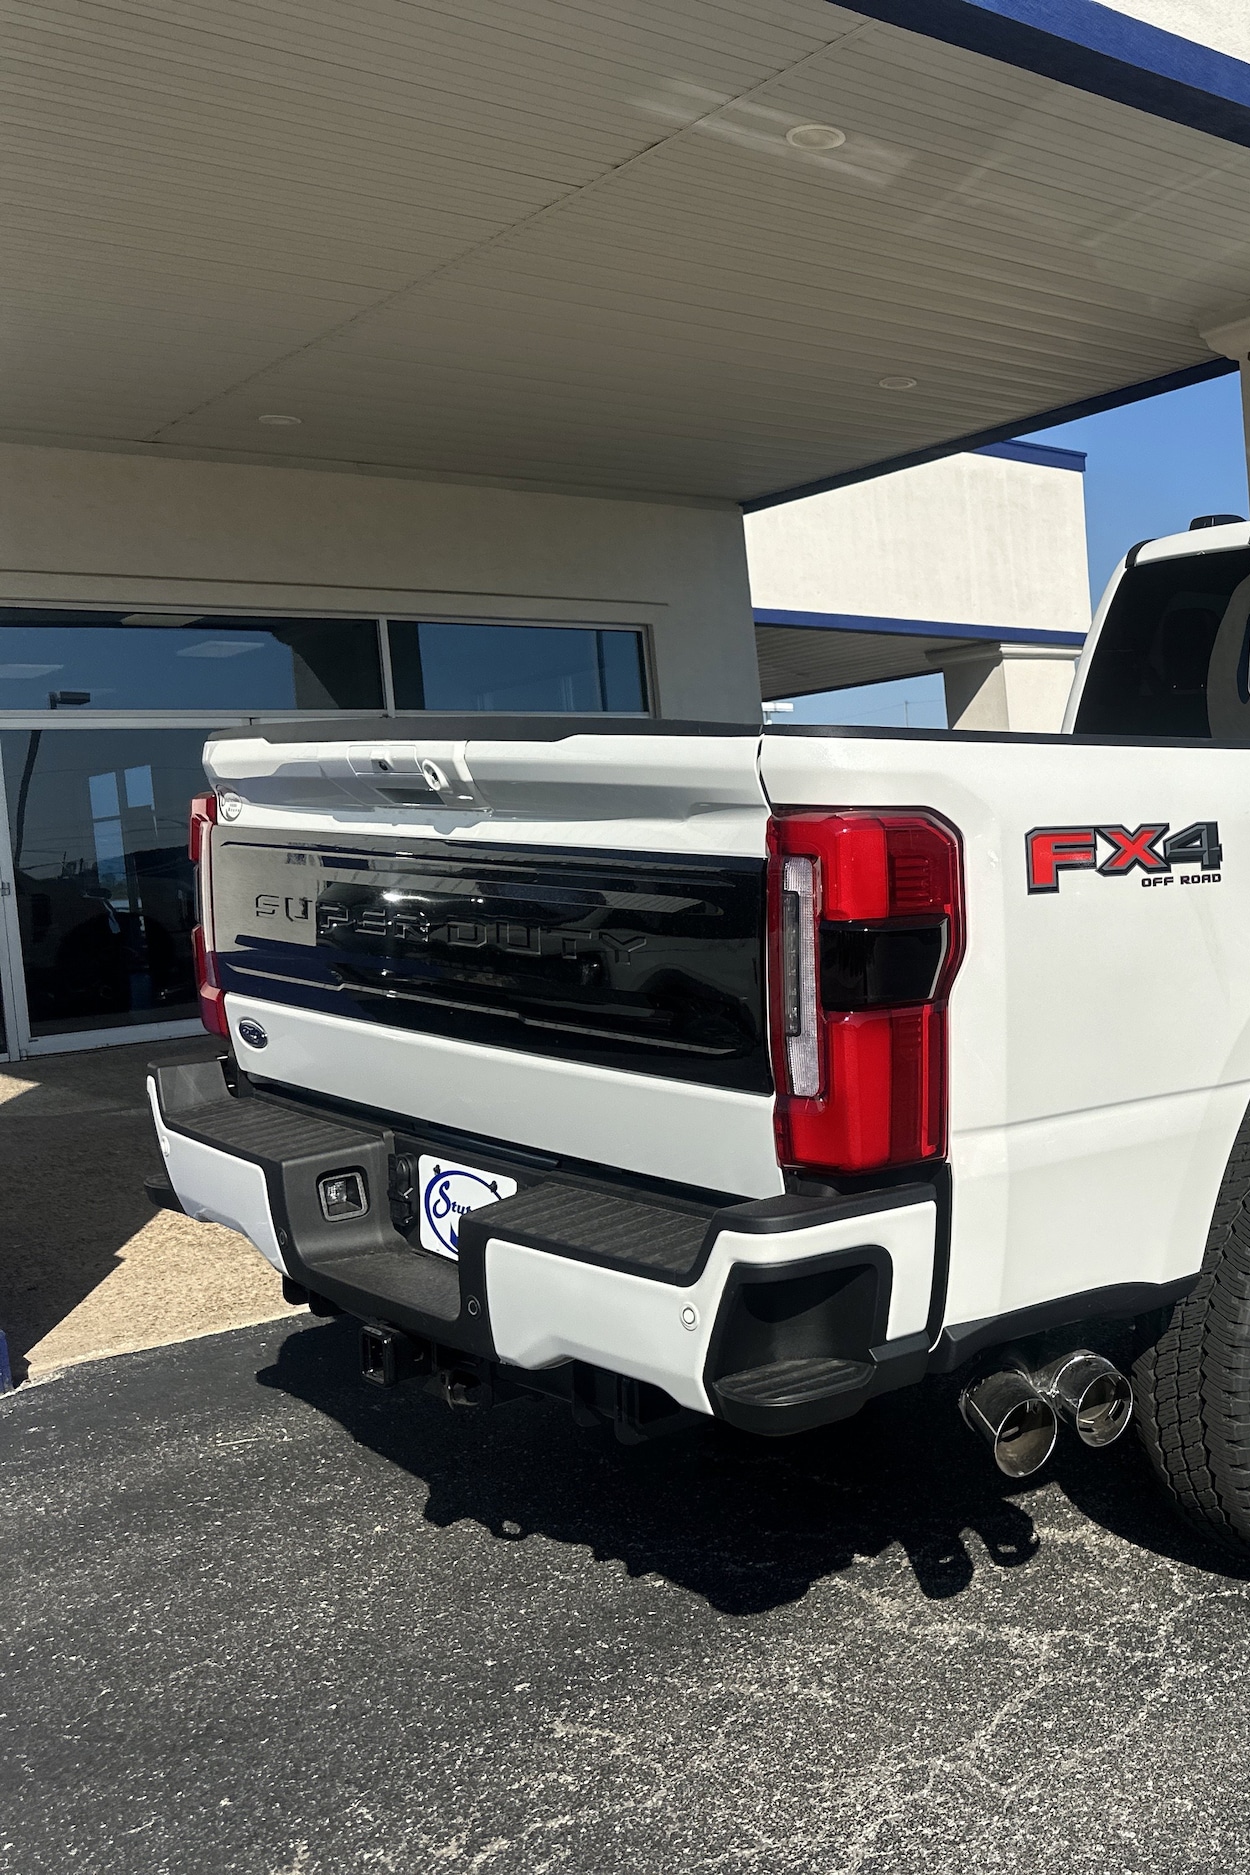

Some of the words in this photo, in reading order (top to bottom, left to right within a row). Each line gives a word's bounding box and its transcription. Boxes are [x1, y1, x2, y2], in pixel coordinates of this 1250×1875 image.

[1024, 821, 1223, 895] FX4
[1141, 875, 1174, 888] OFF
[1180, 873, 1222, 886] ROAD
[255, 894, 430, 943] SUPER
[446, 914, 647, 966] DUTY
